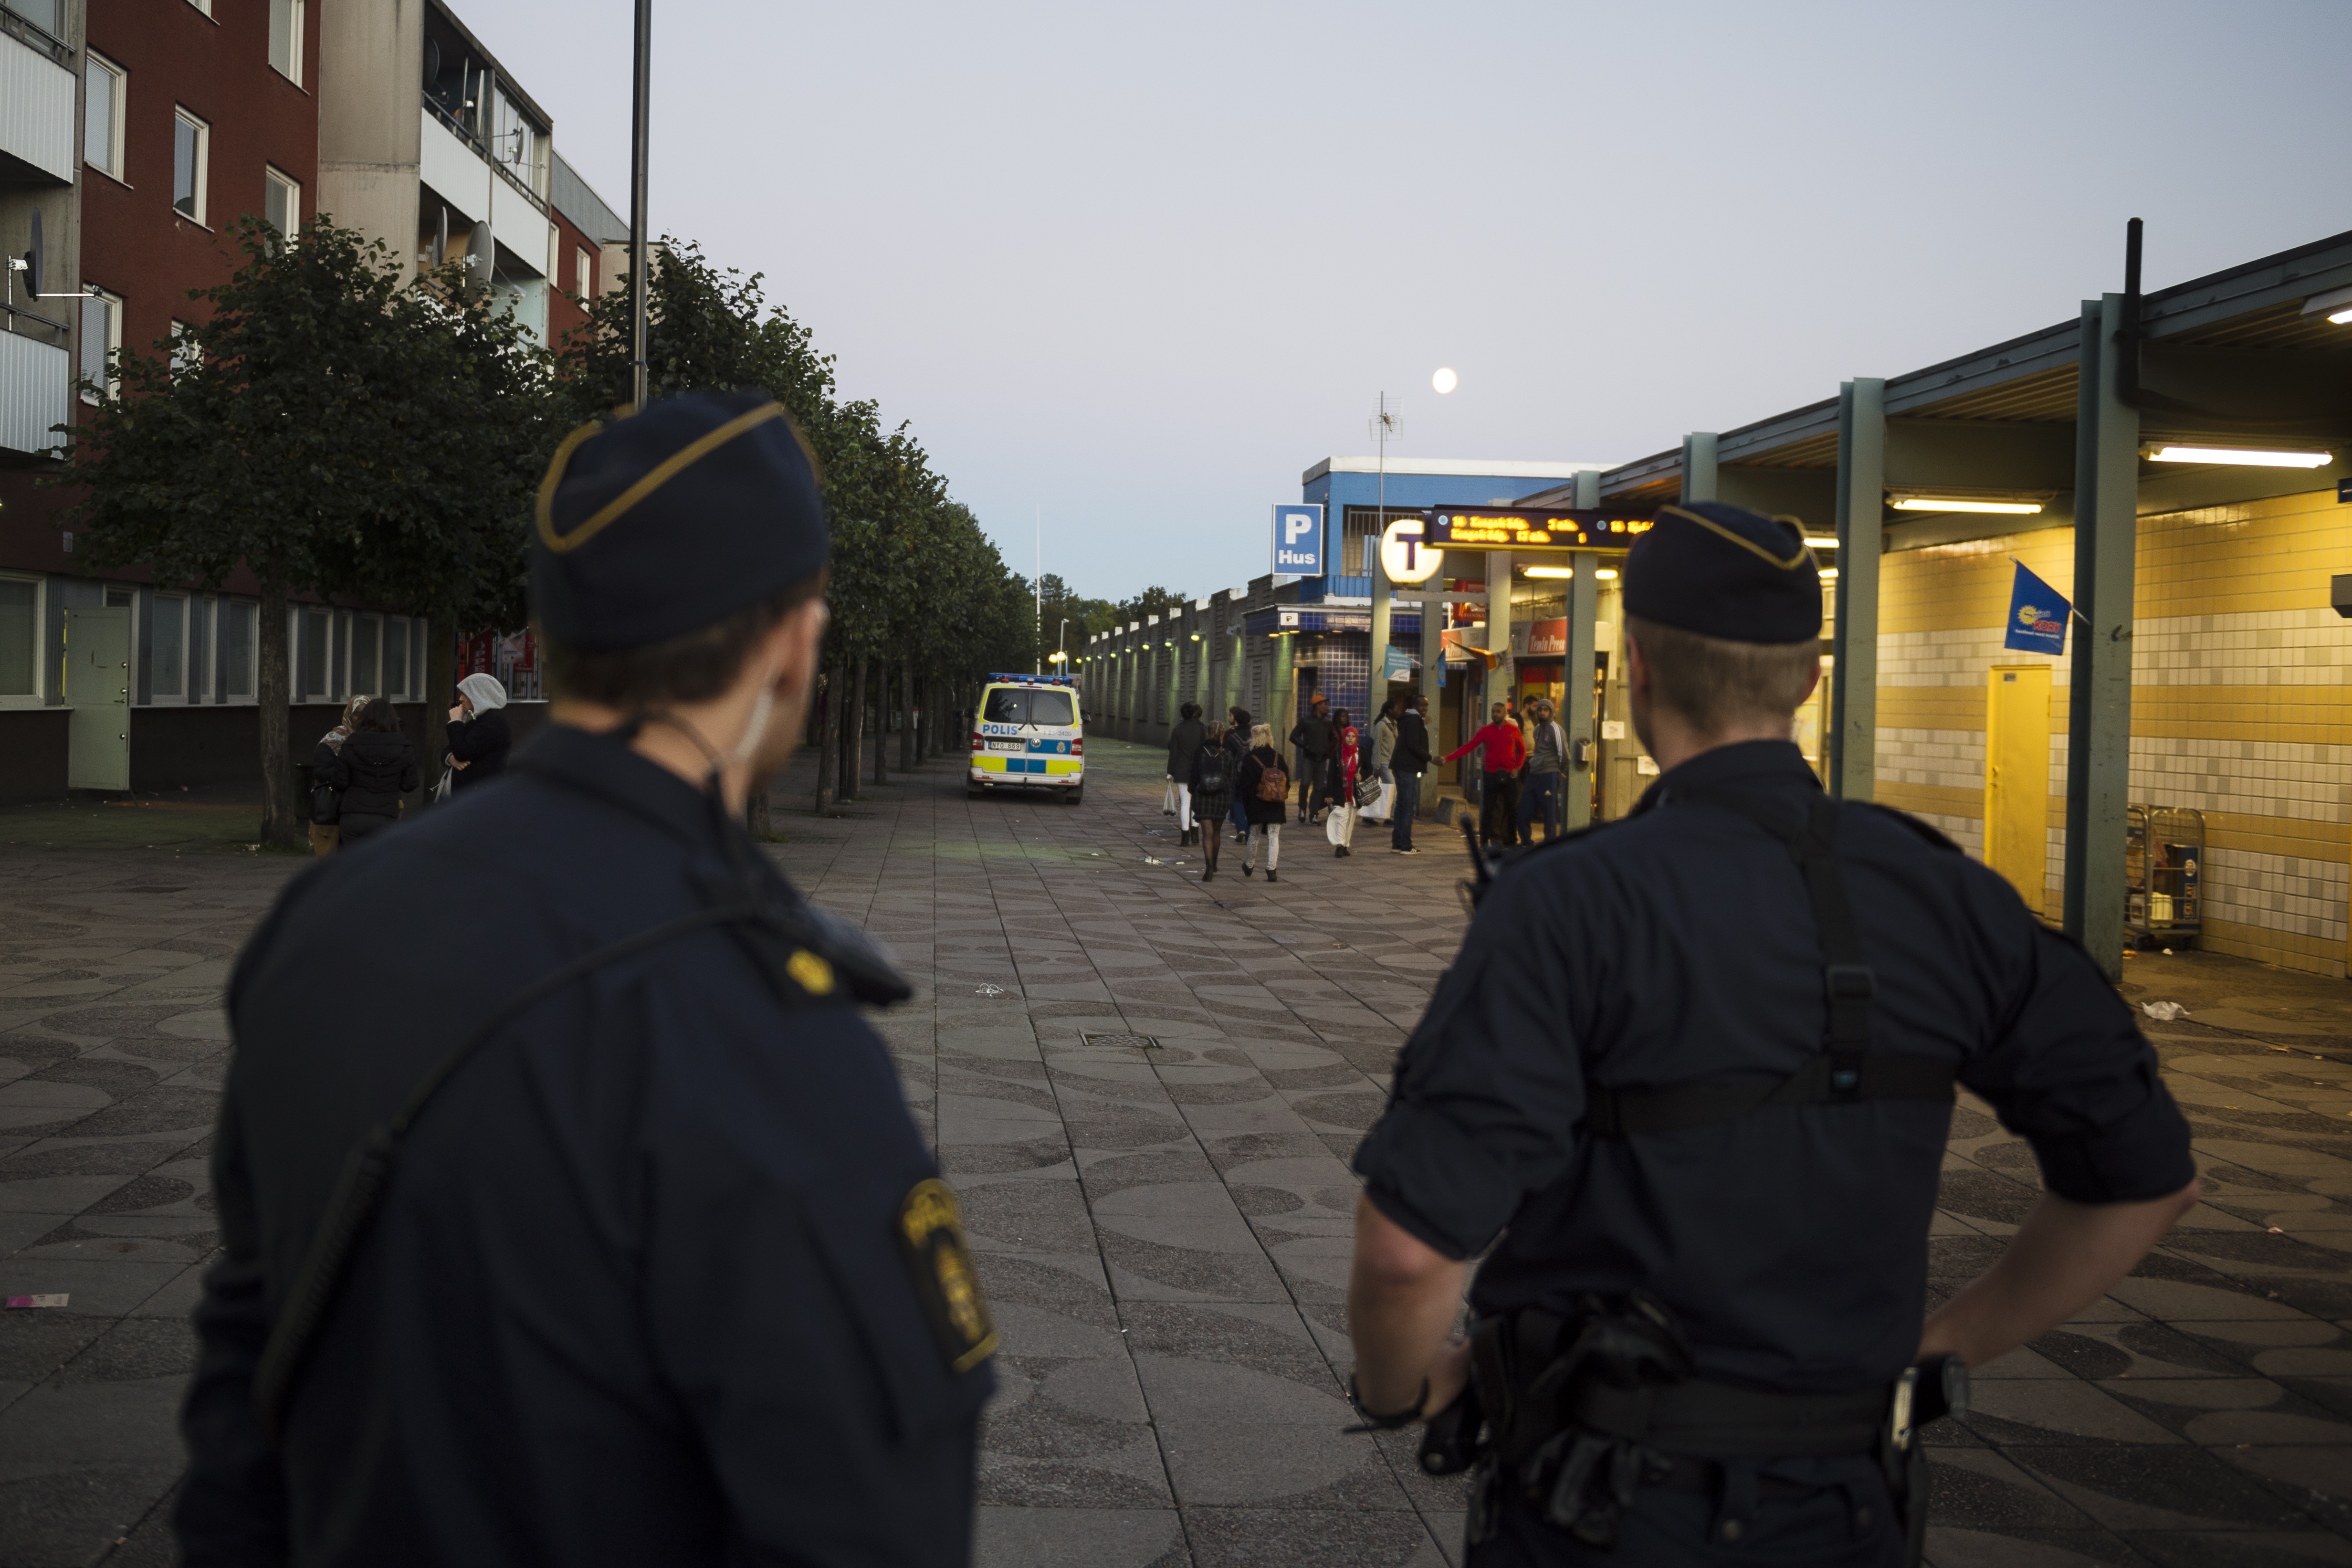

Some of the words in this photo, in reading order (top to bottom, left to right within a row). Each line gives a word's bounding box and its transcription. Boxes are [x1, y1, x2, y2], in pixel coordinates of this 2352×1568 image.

[1286, 514, 1312, 544] P
[1279, 550, 1315, 564] Hus
[1395, 533, 1422, 571] T
[2033, 620, 2061, 633] KORV
[982, 725, 1018, 735] POLIS
